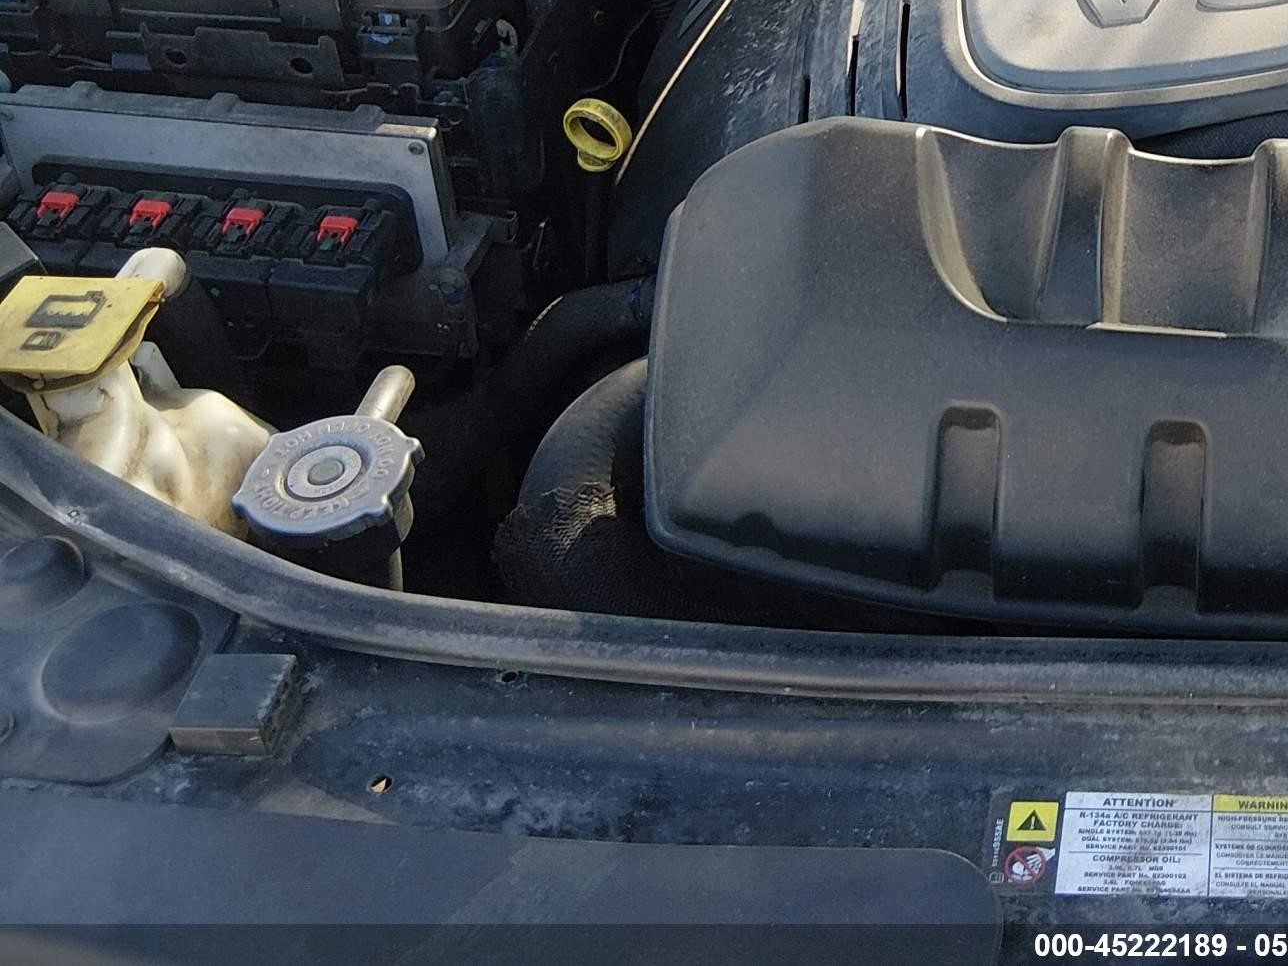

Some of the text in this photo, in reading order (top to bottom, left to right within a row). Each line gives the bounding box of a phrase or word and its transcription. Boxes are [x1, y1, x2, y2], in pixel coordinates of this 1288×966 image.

[1103, 798, 1174, 808] ATTENTION
[1079, 811, 1198, 821] R-134a A/C REFRIGERANT
[1093, 819, 1138, 827] FACTORY
